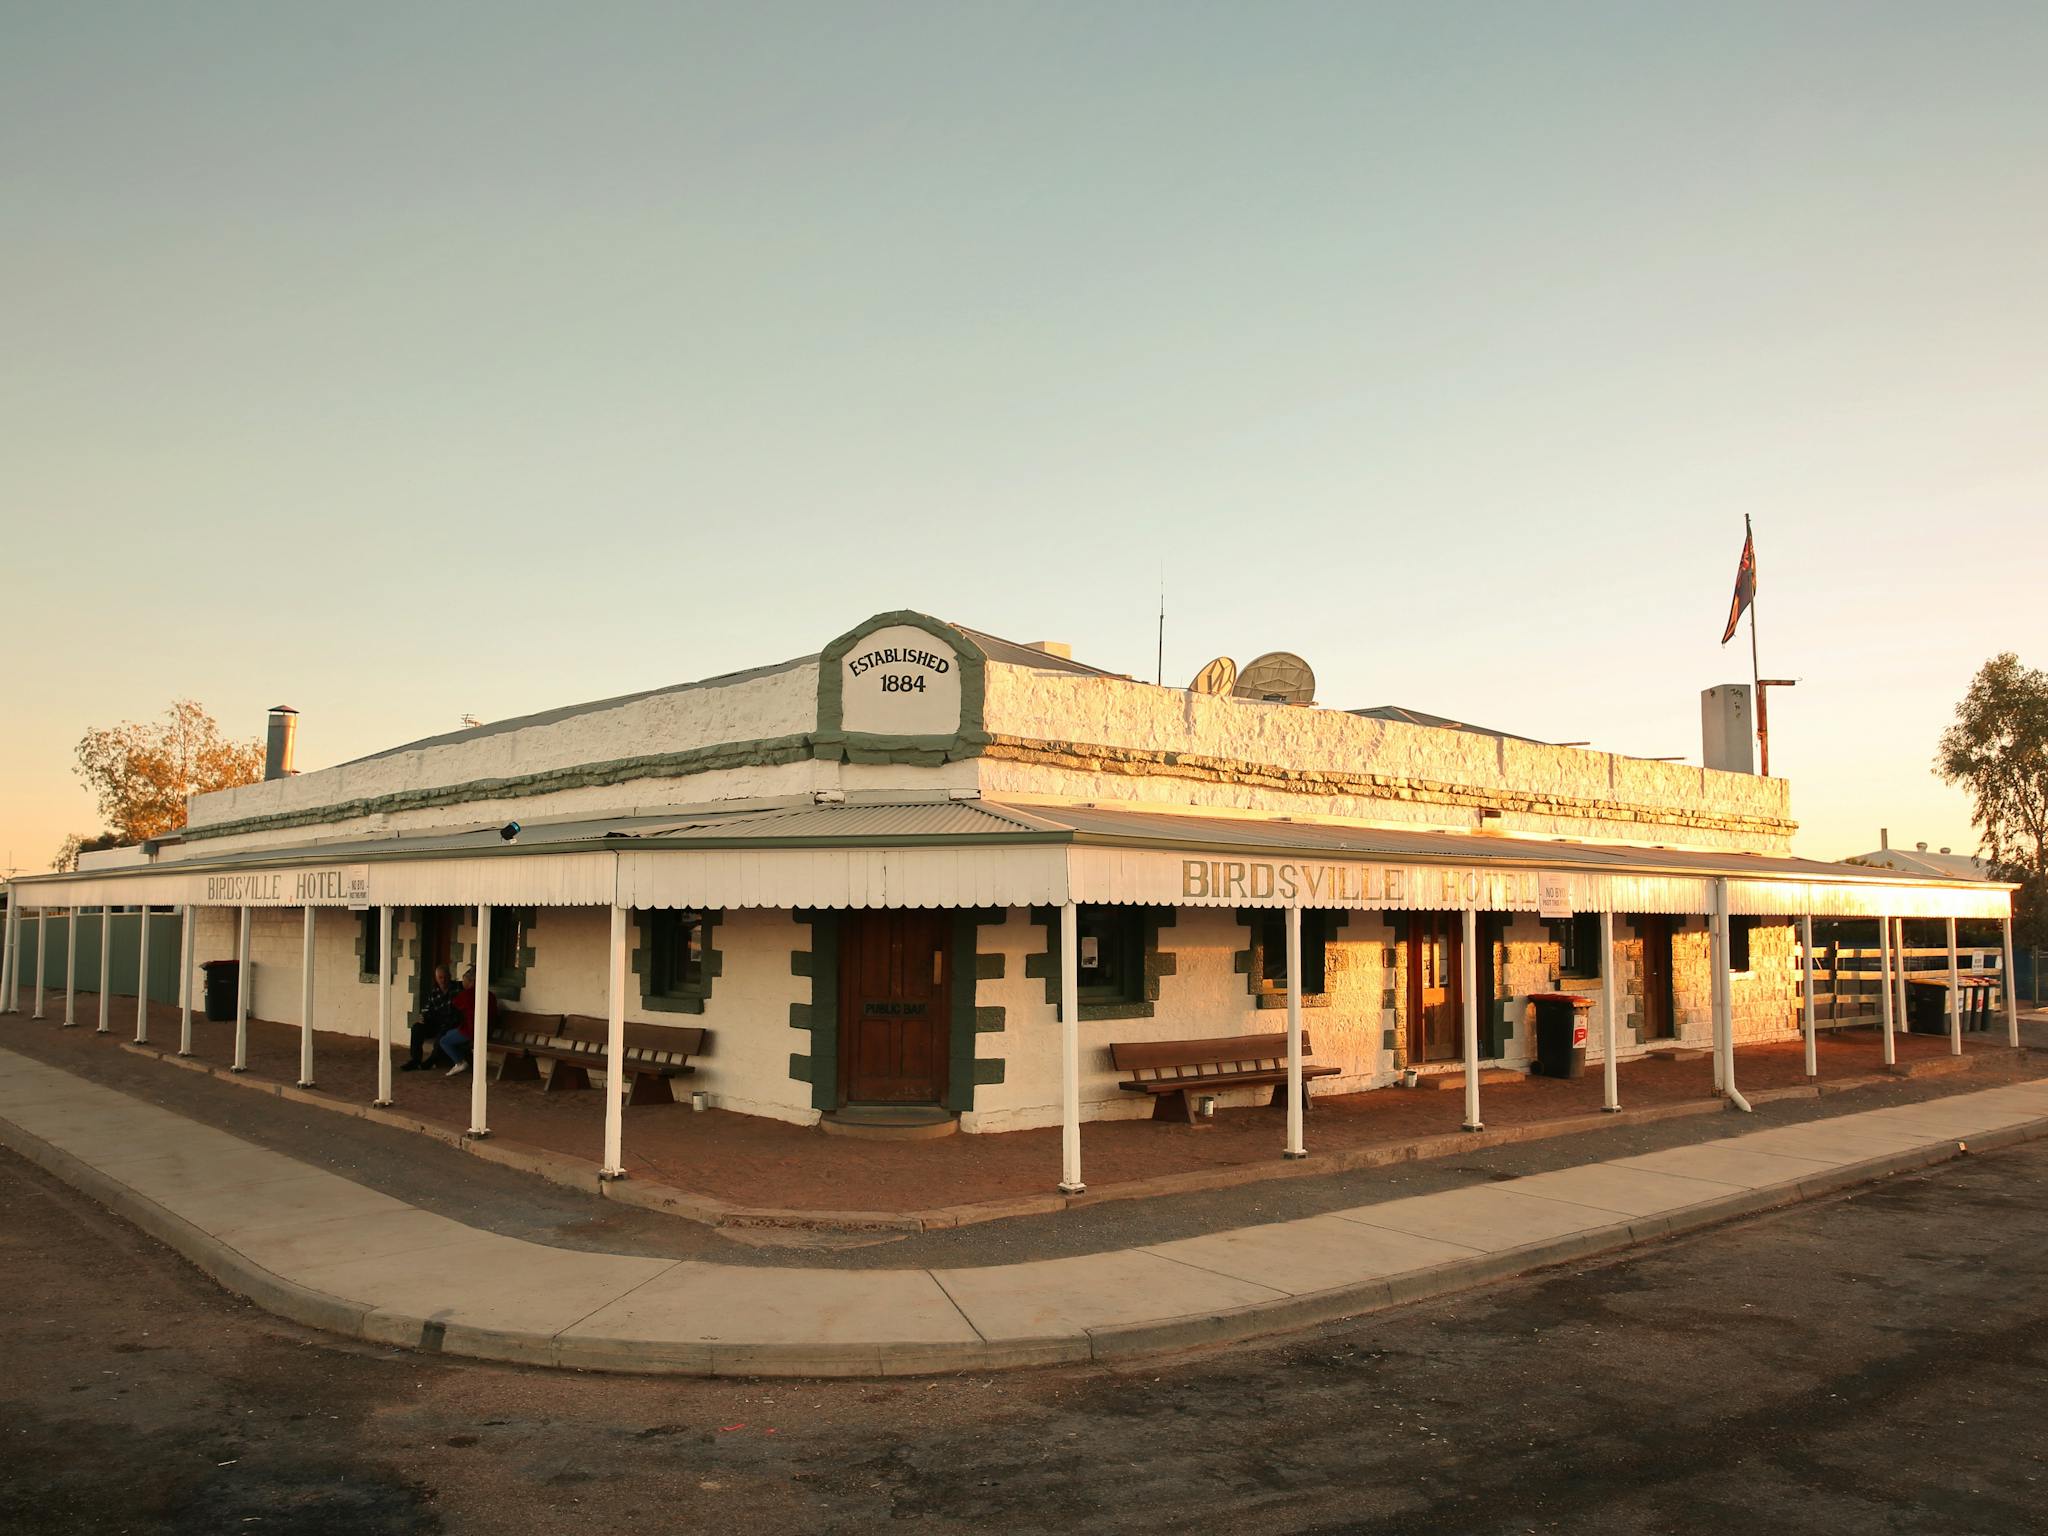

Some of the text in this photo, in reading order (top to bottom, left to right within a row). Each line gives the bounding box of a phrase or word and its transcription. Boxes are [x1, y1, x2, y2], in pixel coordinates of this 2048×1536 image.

[848, 648, 950, 677] ESTABLISHED
[880, 674, 926, 692] 1884
[208, 871, 348, 900] BIRDSVILLE HOTEL
[1182, 860, 1537, 904] BIRDSVILLE HOTEL
[1545, 887, 1555, 898] NO
[865, 1003, 901, 1015] PUBLIC
